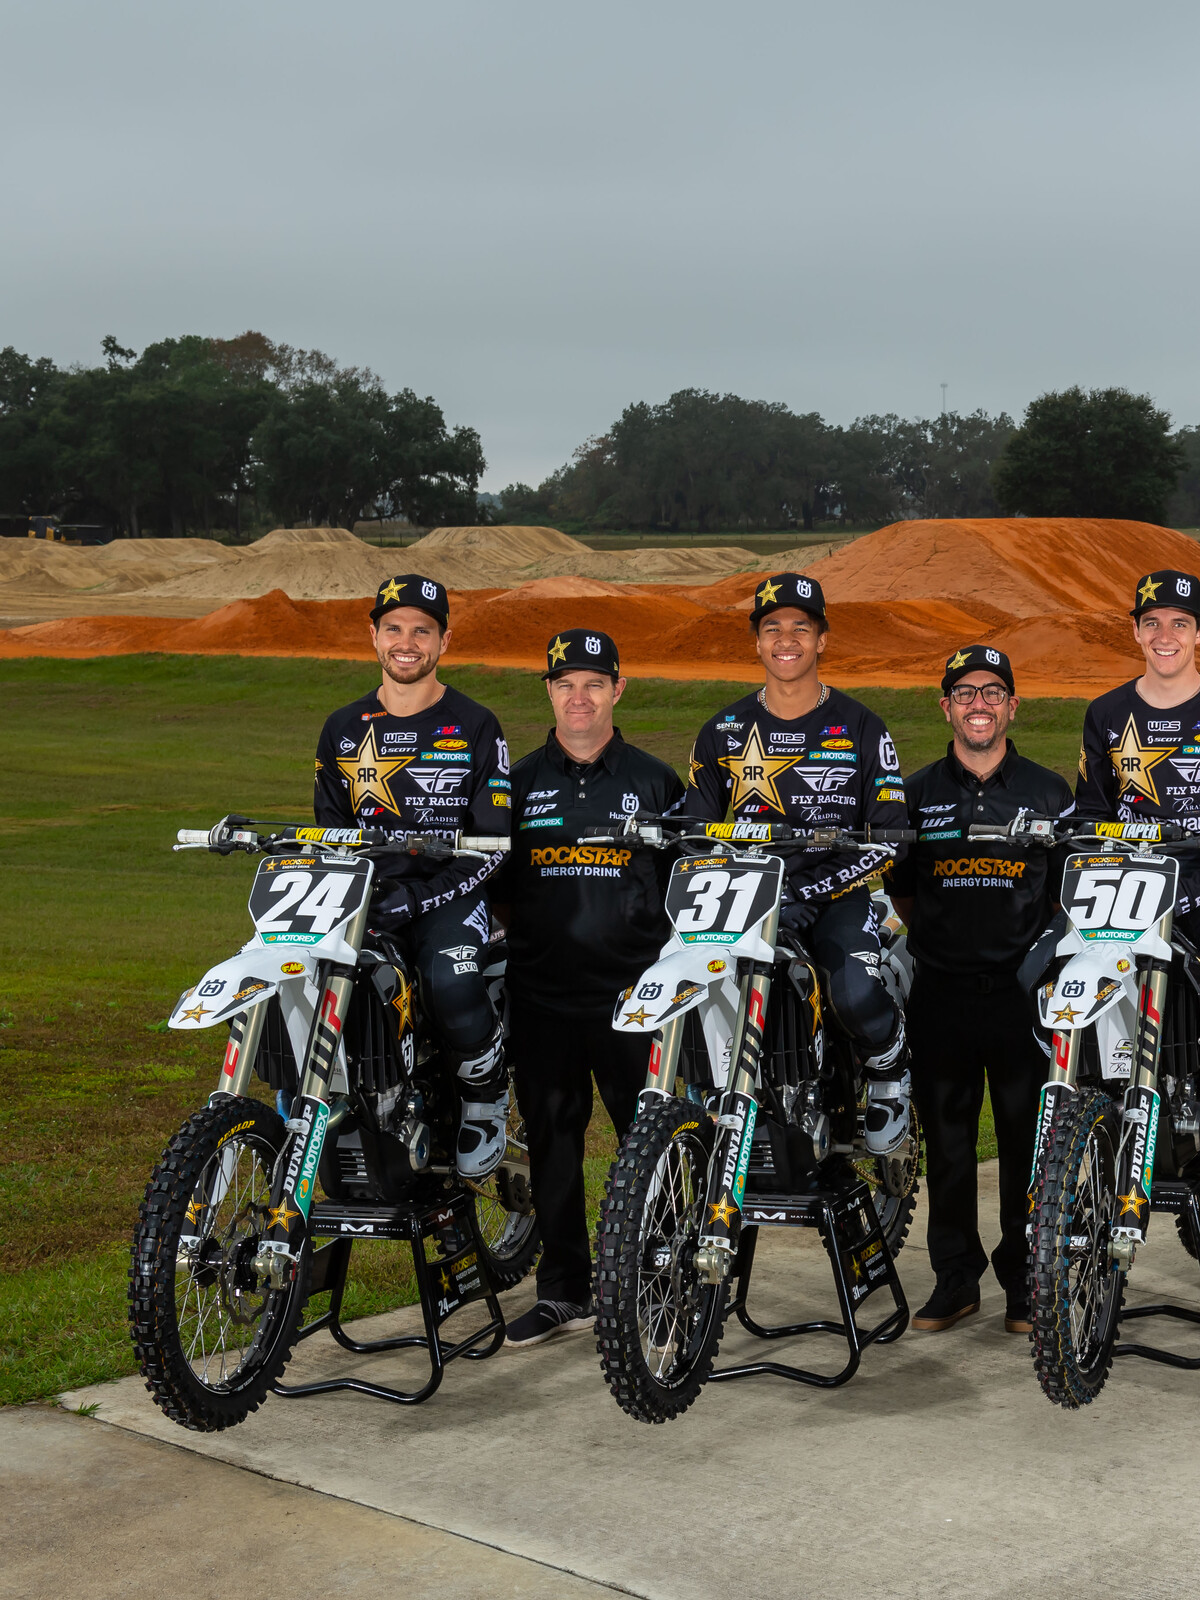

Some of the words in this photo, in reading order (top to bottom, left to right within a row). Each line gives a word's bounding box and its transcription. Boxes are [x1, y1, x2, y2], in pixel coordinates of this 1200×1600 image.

[432, 726, 462, 735] AMA
[715, 722, 746, 731] SENTRY
[819, 725, 849, 735] AMA
[1147, 721, 1181, 731] WPS
[384, 733, 418, 743] WPS
[770, 733, 806, 744] WPS
[433, 740, 468, 750] FMF
[820, 738, 855, 750] FMF
[434, 753, 469, 761] MOTOREX
[822, 752, 855, 761] MOTOREX
[529, 789, 560, 799] FLY
[1166, 786, 1187, 795] FLY
[405, 797, 424, 806] FLY
[791, 796, 814, 805] FLY
[817, 795, 856, 805] RACING
[1123, 794, 1144, 803] WP
[361, 808, 384, 816] WP
[523, 803, 558, 817] WP
[744, 805, 769, 813] WP
[927, 803, 957, 813] FLY
[415, 808, 459, 823] PARADISE
[801, 806, 842, 822] PARADISE
[528, 819, 561, 829] MOTOREX
[921, 817, 955, 829] WP
[926, 830, 959, 840] MOTOREX
[530, 846, 632, 866] ROCKSTAR
[693, 858, 728, 867] ROCKSTAR
[933, 858, 1026, 878] ROCKSTAR
[458, 849, 508, 896] RACIN
[541, 866, 581, 877] ENERGY
[584, 866, 621, 878] DRINK
[799, 877, 834, 900] FLY
[942, 878, 980, 888] ENERGY
[983, 878, 1014, 888] DRINK
[256, 871, 356, 934] 24
[675, 871, 764, 933] 31
[1069, 869, 1167, 930] 50
[276, 934, 316, 942] MOTOREX
[696, 934, 735, 942] MOTOREX
[1097, 931, 1136, 939] MOTOREX
[281, 963, 305, 974] FMF
[707, 960, 727, 973] FMF
[232, 983, 266, 1000] ROCKSTAR
[216, 1119, 256, 1149] DUNLOP
[672, 1121, 700, 1139] DUNLOP
[1146, 1101, 1160, 1166] MOTOREX
[303, 1111, 328, 1179] MOTOREX
[738, 1108, 757, 1173] MOTOREX
[450, 1252, 478, 1276] ROCKSTAR
[852, 1285, 861, 1300] 31
[438, 1297, 449, 1317] 24
